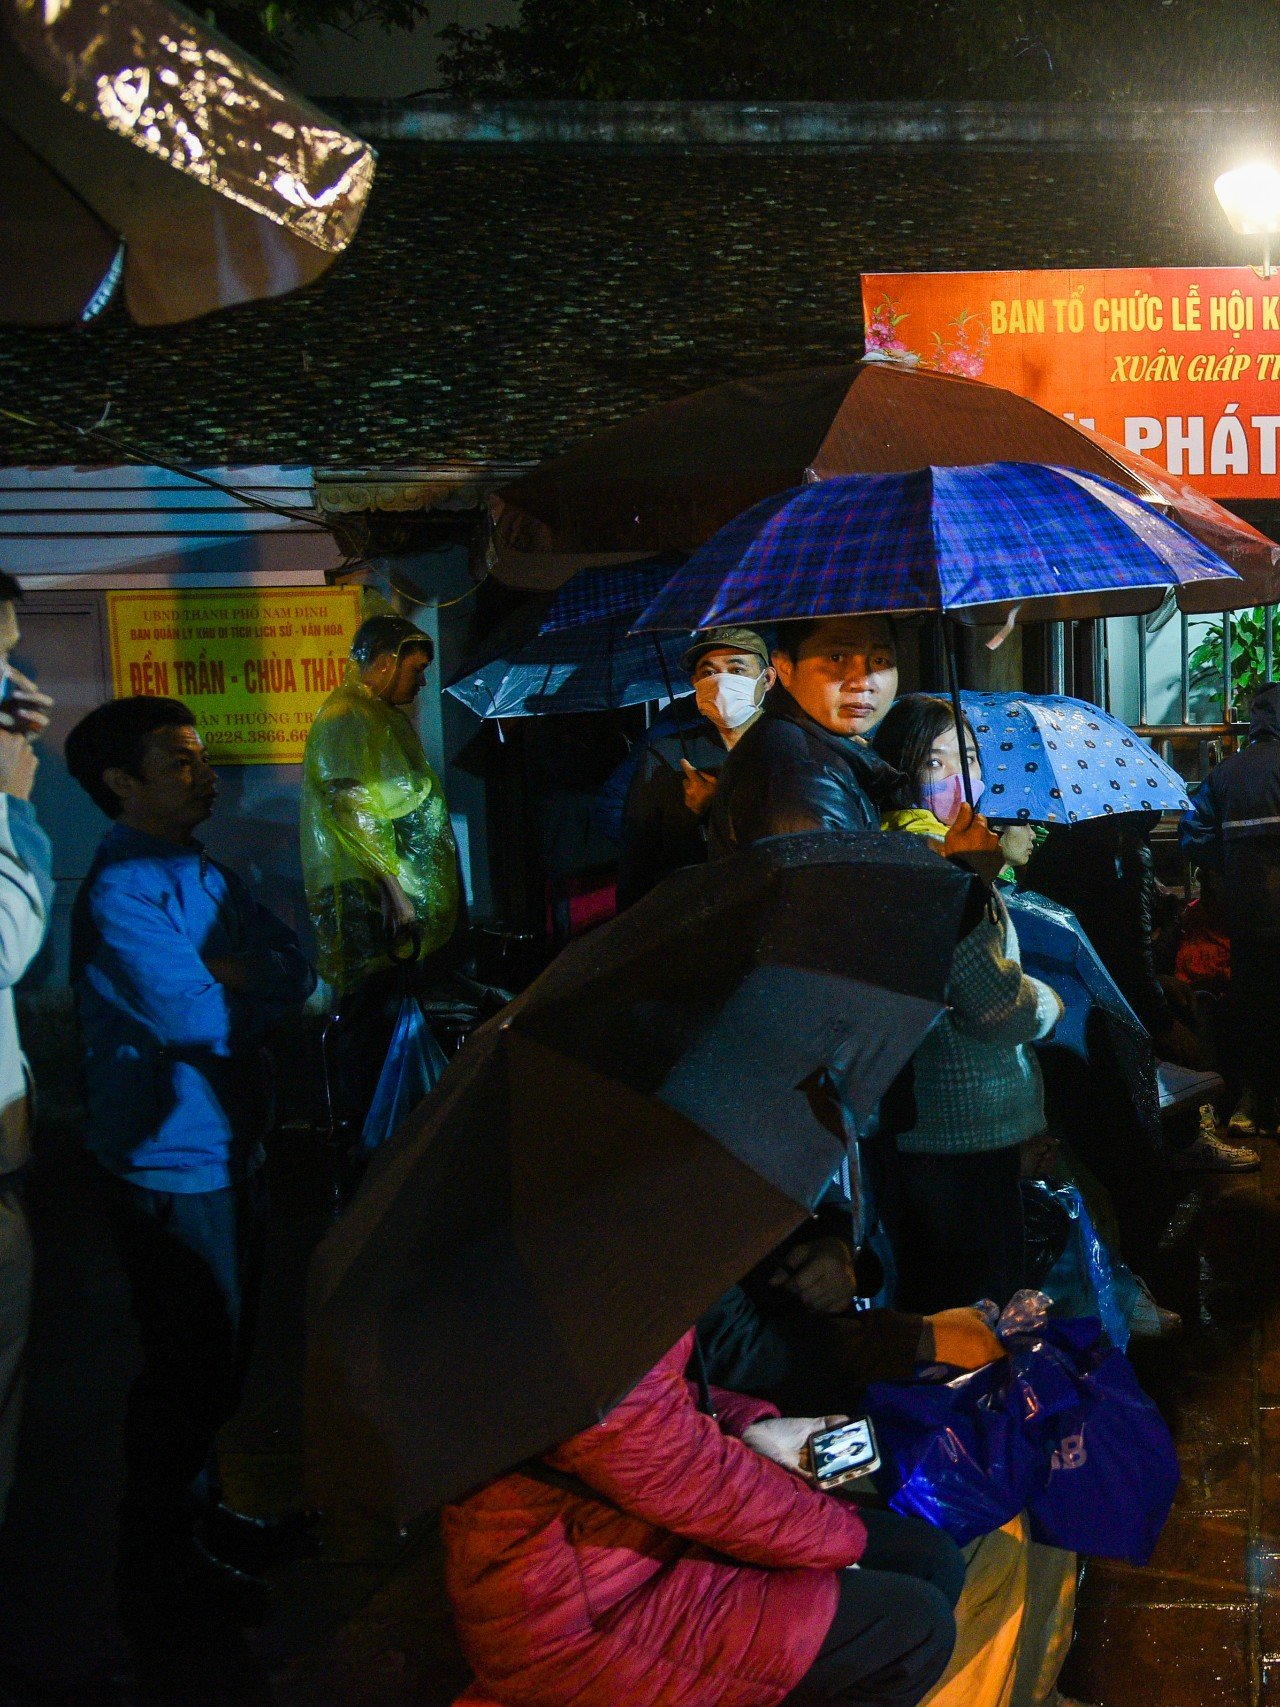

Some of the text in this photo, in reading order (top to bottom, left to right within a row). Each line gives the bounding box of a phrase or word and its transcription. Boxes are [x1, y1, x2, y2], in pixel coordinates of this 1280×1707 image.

[991, 300, 1046, 335] BAN
[1052, 285, 1085, 334] TỔ
[1093, 290, 1163, 333] CHỨC
[1172, 284, 1202, 332] LỄ
[1210, 289, 1254, 339] HỘI
[1110, 347, 1185, 383] XUÂN
[1187, 346, 1251, 382] GIÁP
[143, 609, 180, 621] UBND
[263, 607, 291, 618] NAM
[130, 628, 151, 641] BAN
[129, 649, 169, 695] ĐỀN
[173, 648, 225, 695] TRẦN
[243, 651, 297, 694] CHÙA
[294, 712, 313, 723] TR
[205, 729, 308, 744] 0228.3866.66
